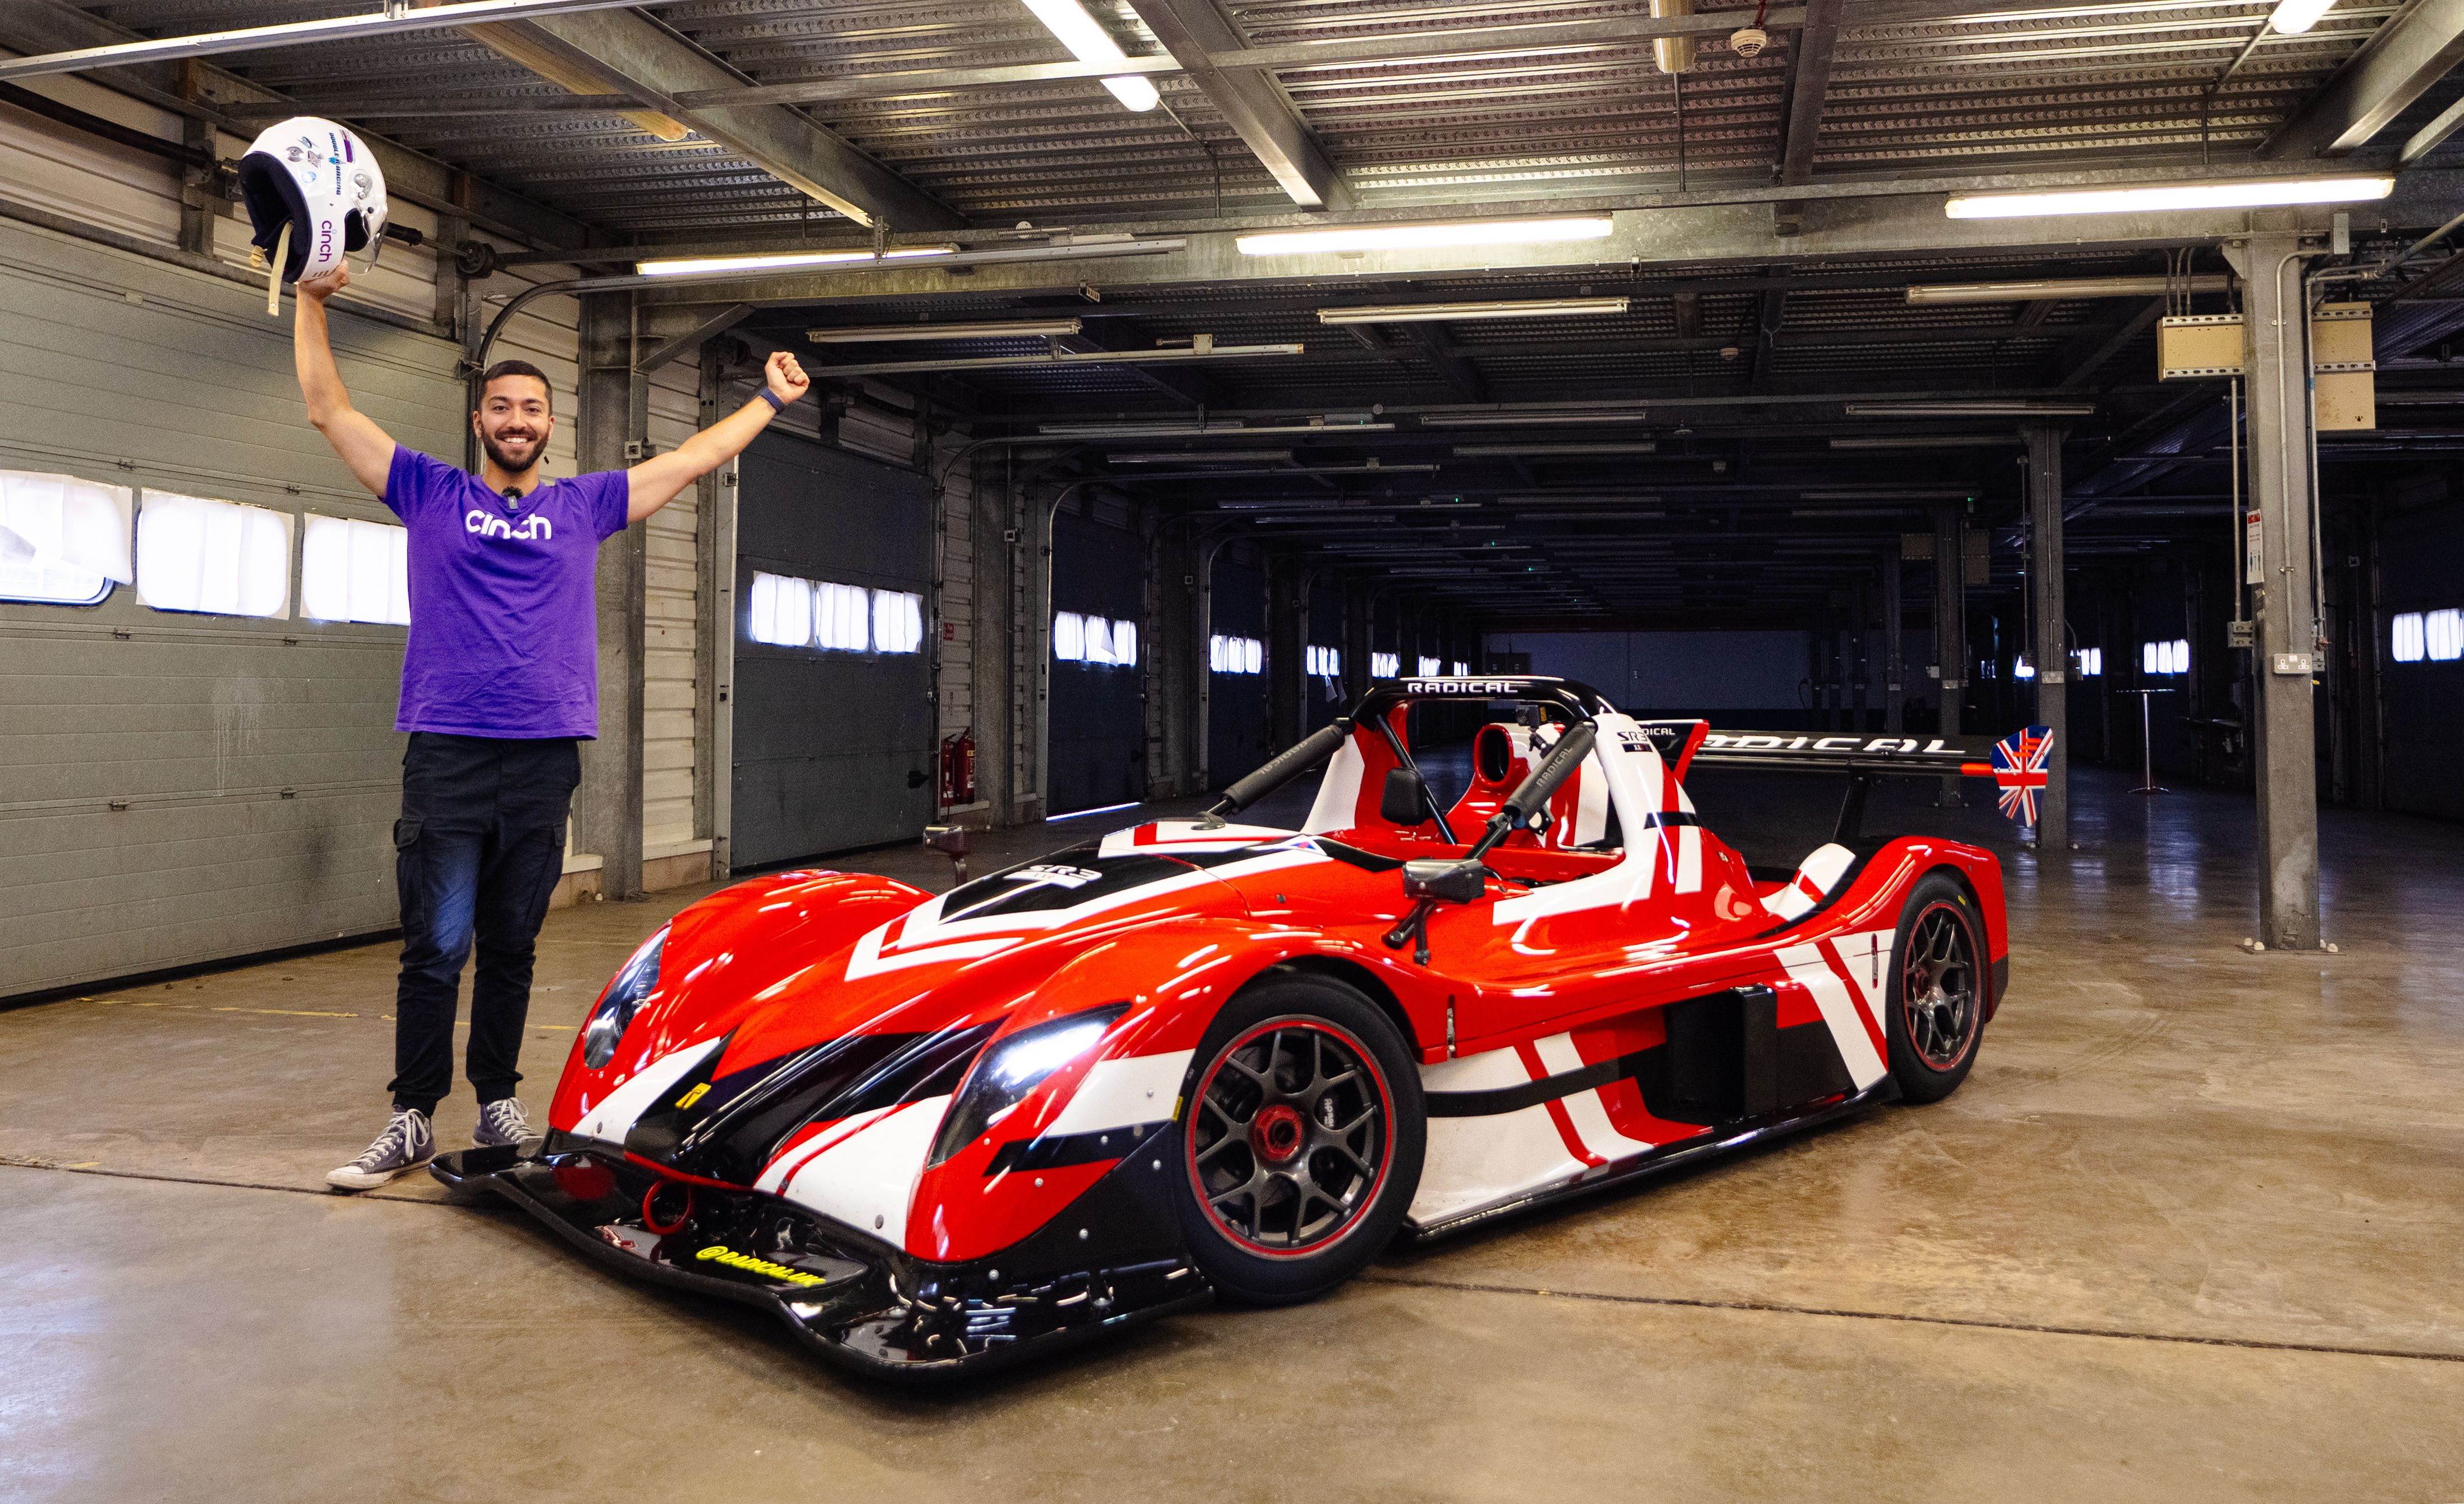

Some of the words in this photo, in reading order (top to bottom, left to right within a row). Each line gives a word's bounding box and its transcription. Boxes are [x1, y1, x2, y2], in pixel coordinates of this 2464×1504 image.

[328, 132, 340, 157] DOUBLE
[318, 220, 337, 262] cinch
[465, 509, 552, 540] cinch
[1407, 682, 1518, 693] RADICAL
[1617, 731, 1648, 742] SR3
[1703, 734, 1965, 753] ADICAL
[1257, 741, 1308, 774] RADICAL
[1535, 747, 1572, 787] RADICAL
[1020, 865, 1102, 882] SR3
